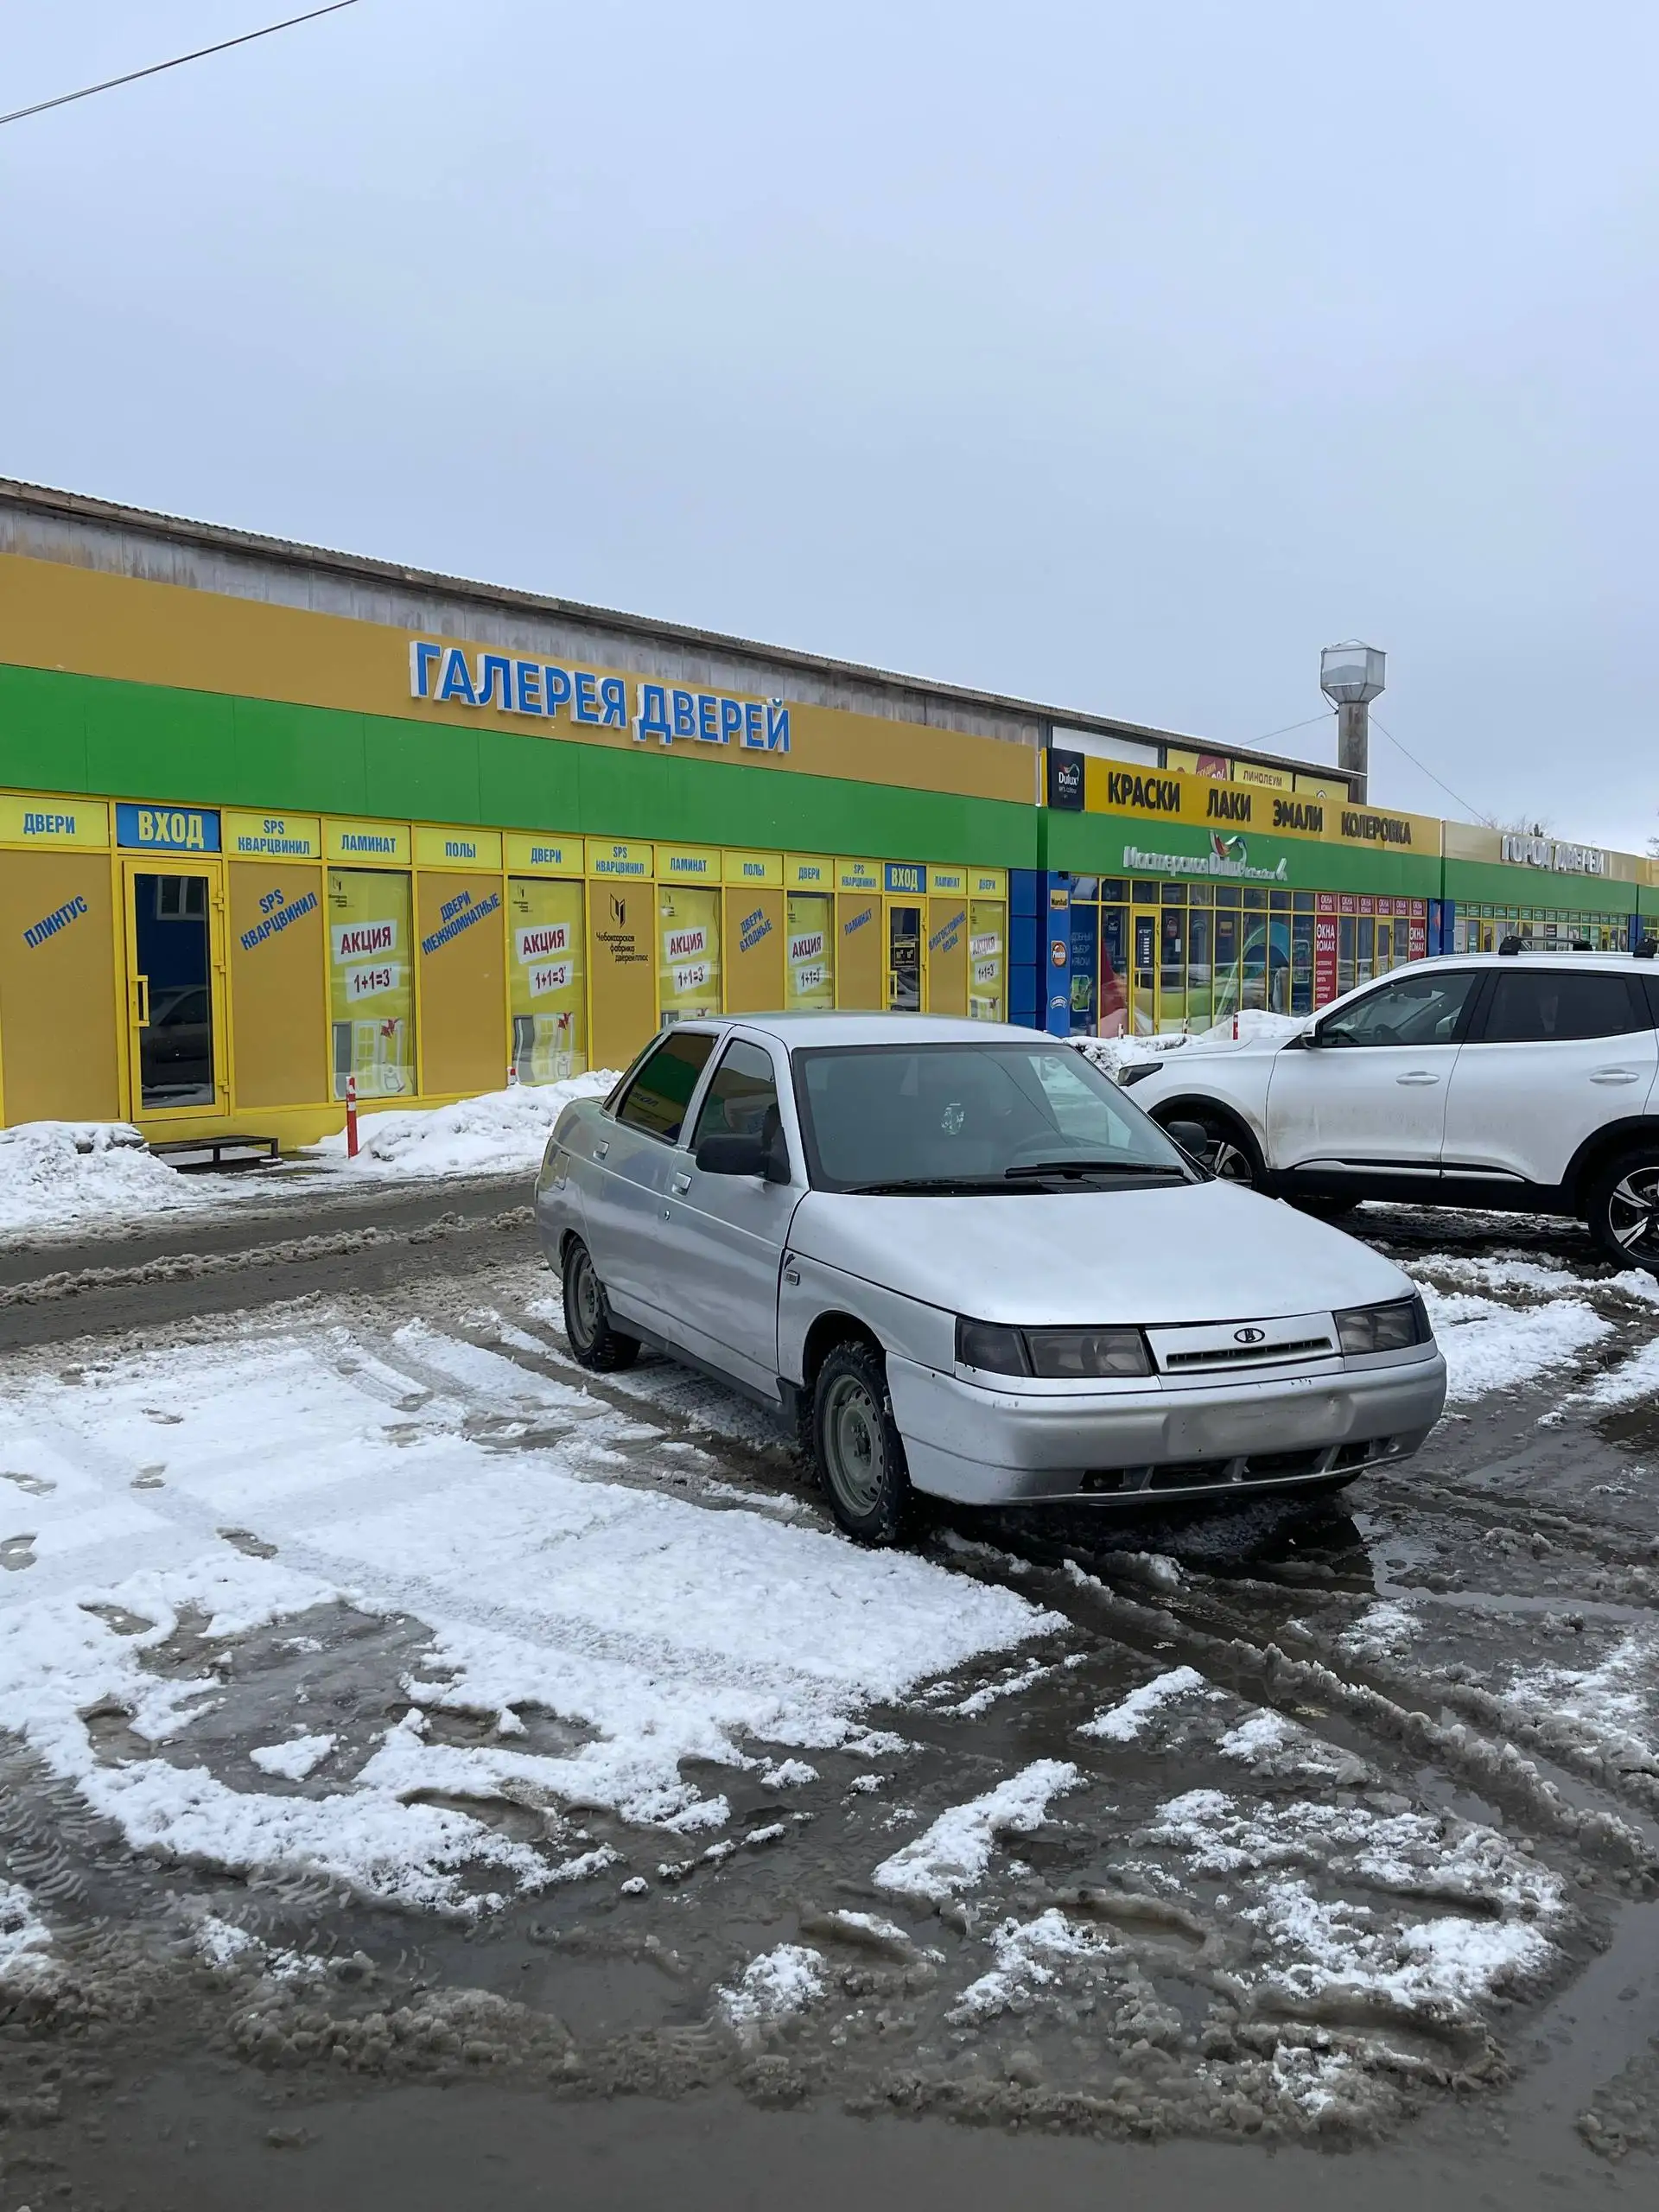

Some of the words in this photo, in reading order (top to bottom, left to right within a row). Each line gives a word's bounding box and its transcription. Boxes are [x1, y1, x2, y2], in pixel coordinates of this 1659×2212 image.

[410, 640, 627, 728] ГАЛЕРЕЯ
[632, 683, 791, 753] ДВЕРЕЙ
[1058, 772, 1078, 785] Dulux
[1243, 770, 1282, 787] ЛИНОЛЕУМ
[1108, 772, 1180, 812] КРАСКИ
[1206, 788, 1251, 822] ЛАКИ
[1273, 799, 1323, 832] ЭМАЛИ
[1341, 810, 1412, 845] КОЛЕРОВКА
[23, 811, 76, 835] ДВЕРИ
[138, 810, 204, 849] ВХОД
[263, 820, 284, 835] SPS
[238, 838, 310, 855] КВАРЦВИНИЛ
[341, 835, 396, 854] ЛАМИНАТ
[445, 842, 476, 858] ПОЛЫ
[613, 846, 627, 858] SPS
[531, 848, 562, 863] ДВЕРИ
[595, 861, 644, 874] КВАРЦВИНИЛ
[671, 858, 707, 873] ЛАМИНАТ
[743, 863, 765, 876] ПОЛЫ
[798, 867, 820, 880] ДВЕРИ
[854, 864, 864, 874] SPS
[891, 868, 918, 891] ВХОД
[934, 876, 960, 887] ЛАМИНАТ
[979, 878, 995, 890] ДВЕРИ
[259, 889, 284, 914] SPS
[441, 891, 472, 923] ДВЕРИ
[23, 895, 88, 949] ПЛИНТУС
[240, 892, 318, 950] КВАРЦВИНИЛ
[422, 893, 501, 955] МЕЖКОМНАТНЫЕ
[740, 908, 763, 936] ДВЕРИ
[844, 908, 872, 935] ЛАМИНАТ
[340, 926, 391, 955] АКЦИЯ
[595, 931, 635, 945] Чебоксарская
[740, 918, 773, 952] ВХОДНЫЕ
[1316, 924, 1335, 939] ОКНА
[1409, 927, 1425, 941] ОКНА
[523, 929, 565, 955] АКЦИЯ
[610, 944, 635, 956] фабрика
[670, 932, 703, 956] АКЦИЯ
[792, 937, 822, 958] АКЦИЯ
[972, 936, 995, 955] АКЦИЯ
